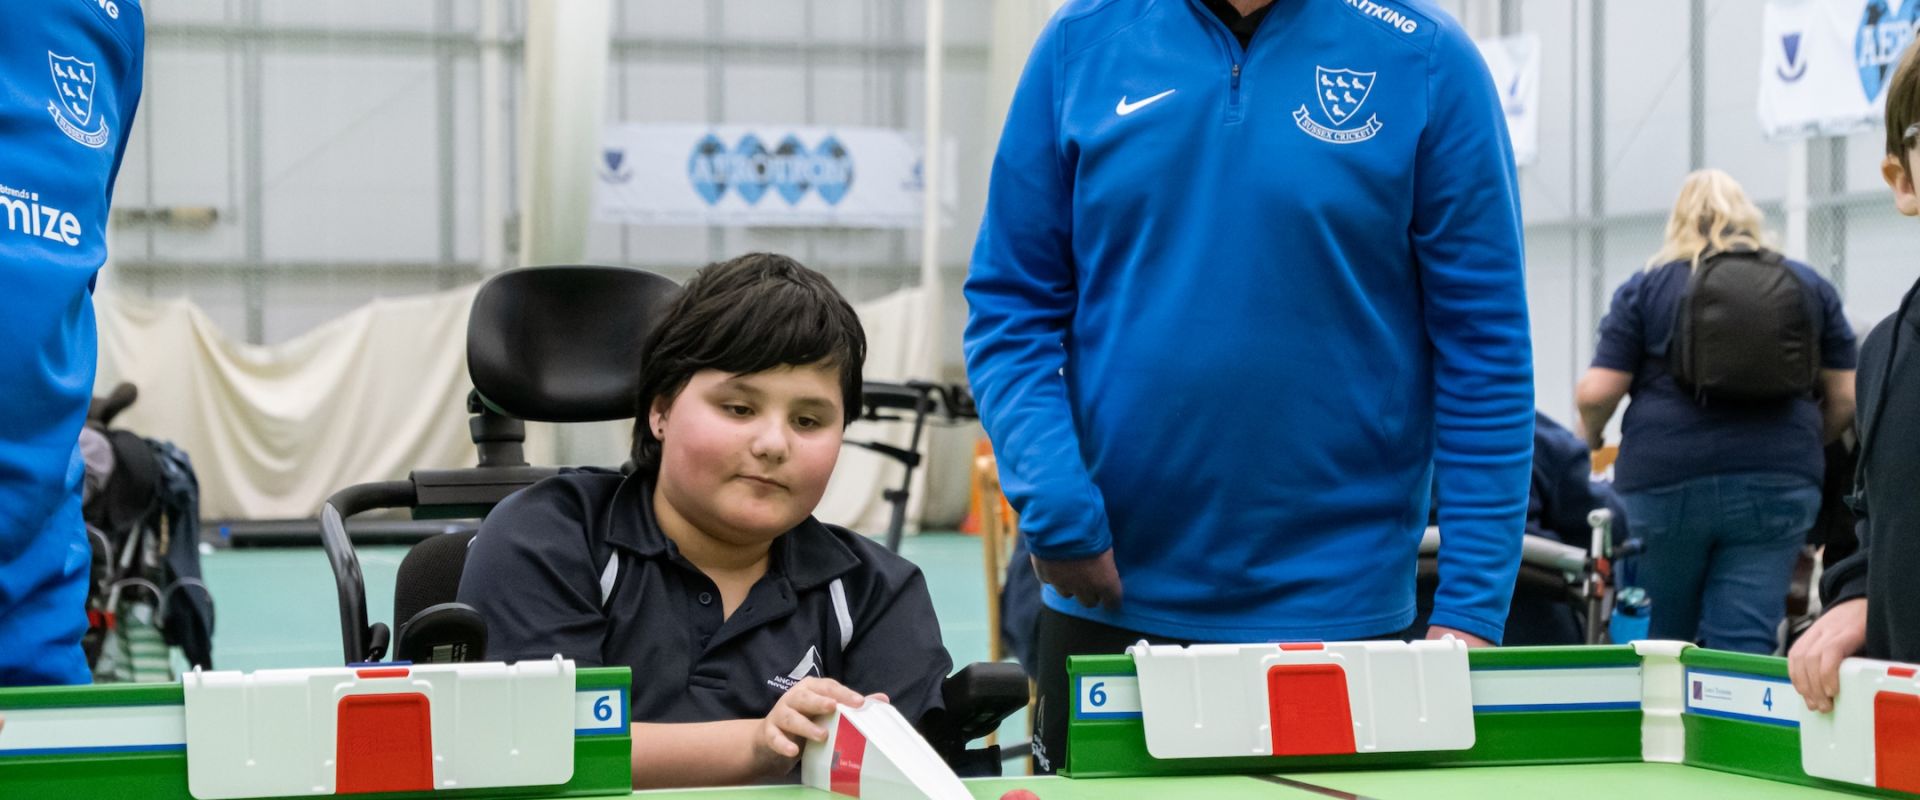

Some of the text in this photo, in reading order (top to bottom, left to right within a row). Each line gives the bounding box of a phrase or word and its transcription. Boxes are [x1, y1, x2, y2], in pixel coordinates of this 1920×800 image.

[1858, 15, 1920, 68] AER
[1301, 118, 1372, 141] SUSSEX CRICKET
[1089, 682, 1107, 707] 6
[1763, 687, 1773, 712] 4
[593, 695, 613, 722] 6
